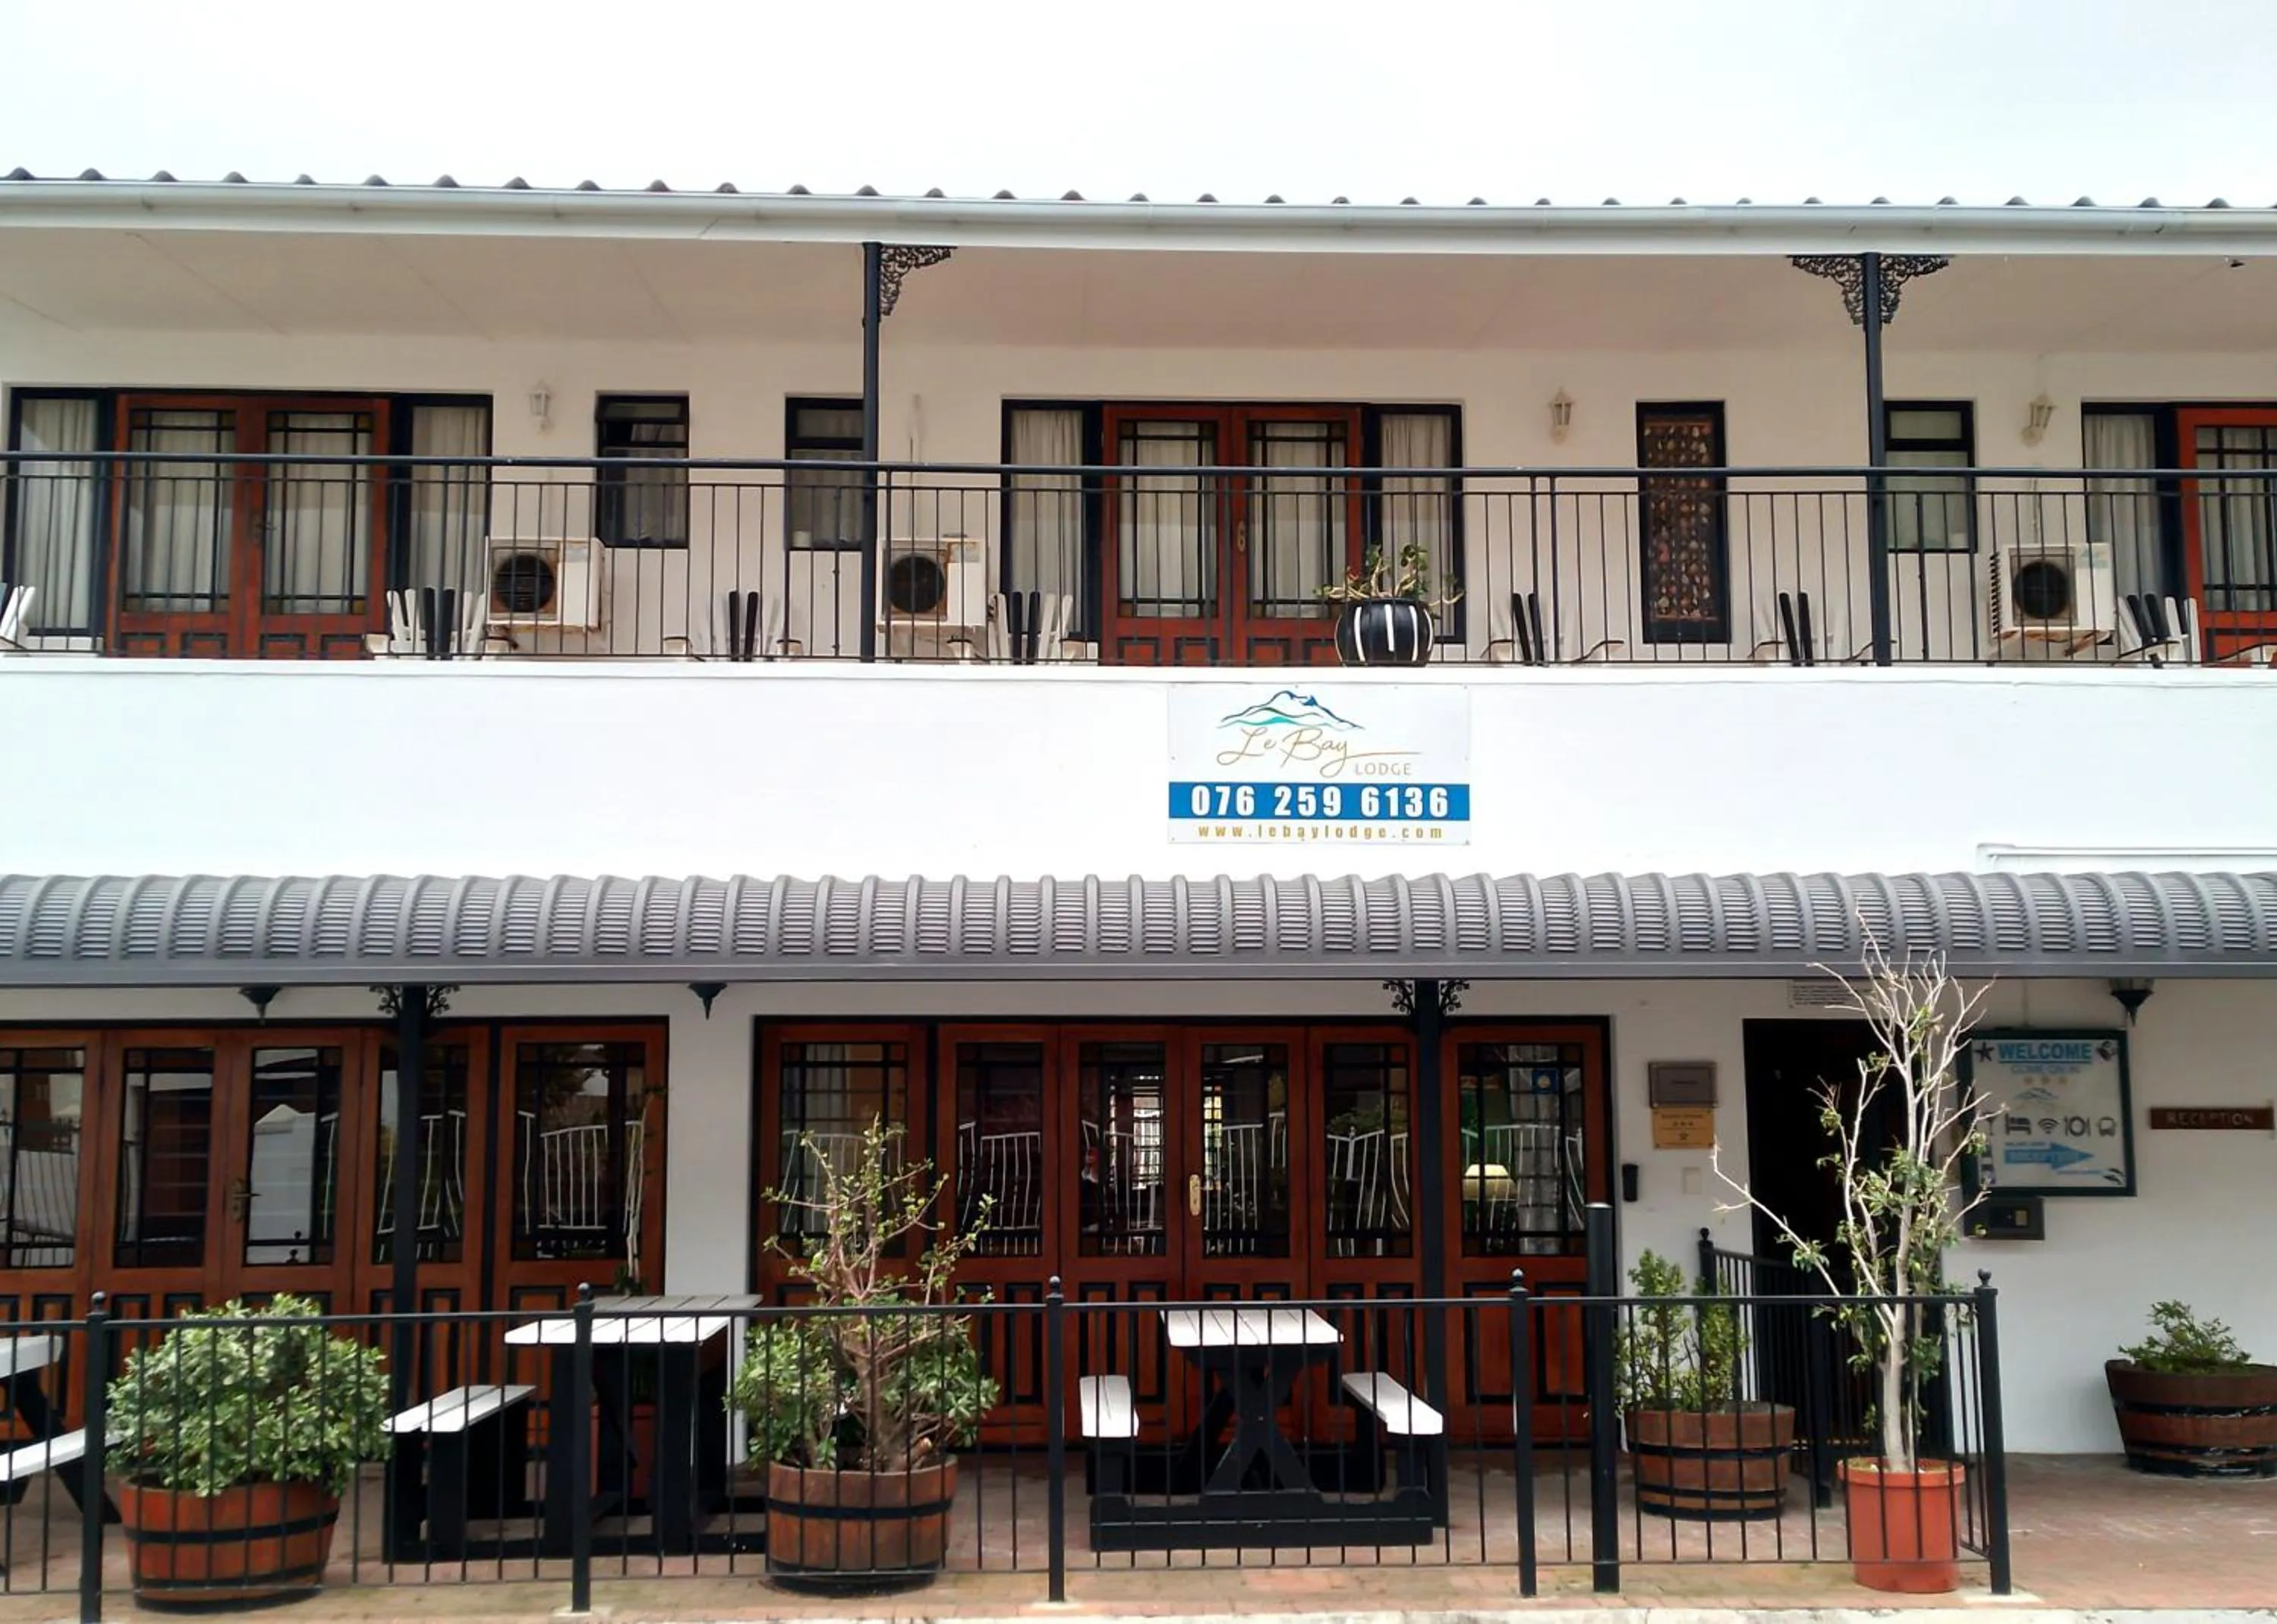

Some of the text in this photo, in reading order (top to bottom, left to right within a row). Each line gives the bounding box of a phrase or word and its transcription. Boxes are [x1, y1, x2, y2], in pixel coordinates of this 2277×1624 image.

[1217, 726, 1276, 766] Le
[1355, 762, 1412, 776] LODGE
[1191, 785, 1449, 817] 076 259 6136
[1198, 823, 1443, 840] www.lebaylodge.com
[1998, 1043, 2093, 1059] WELCOME
